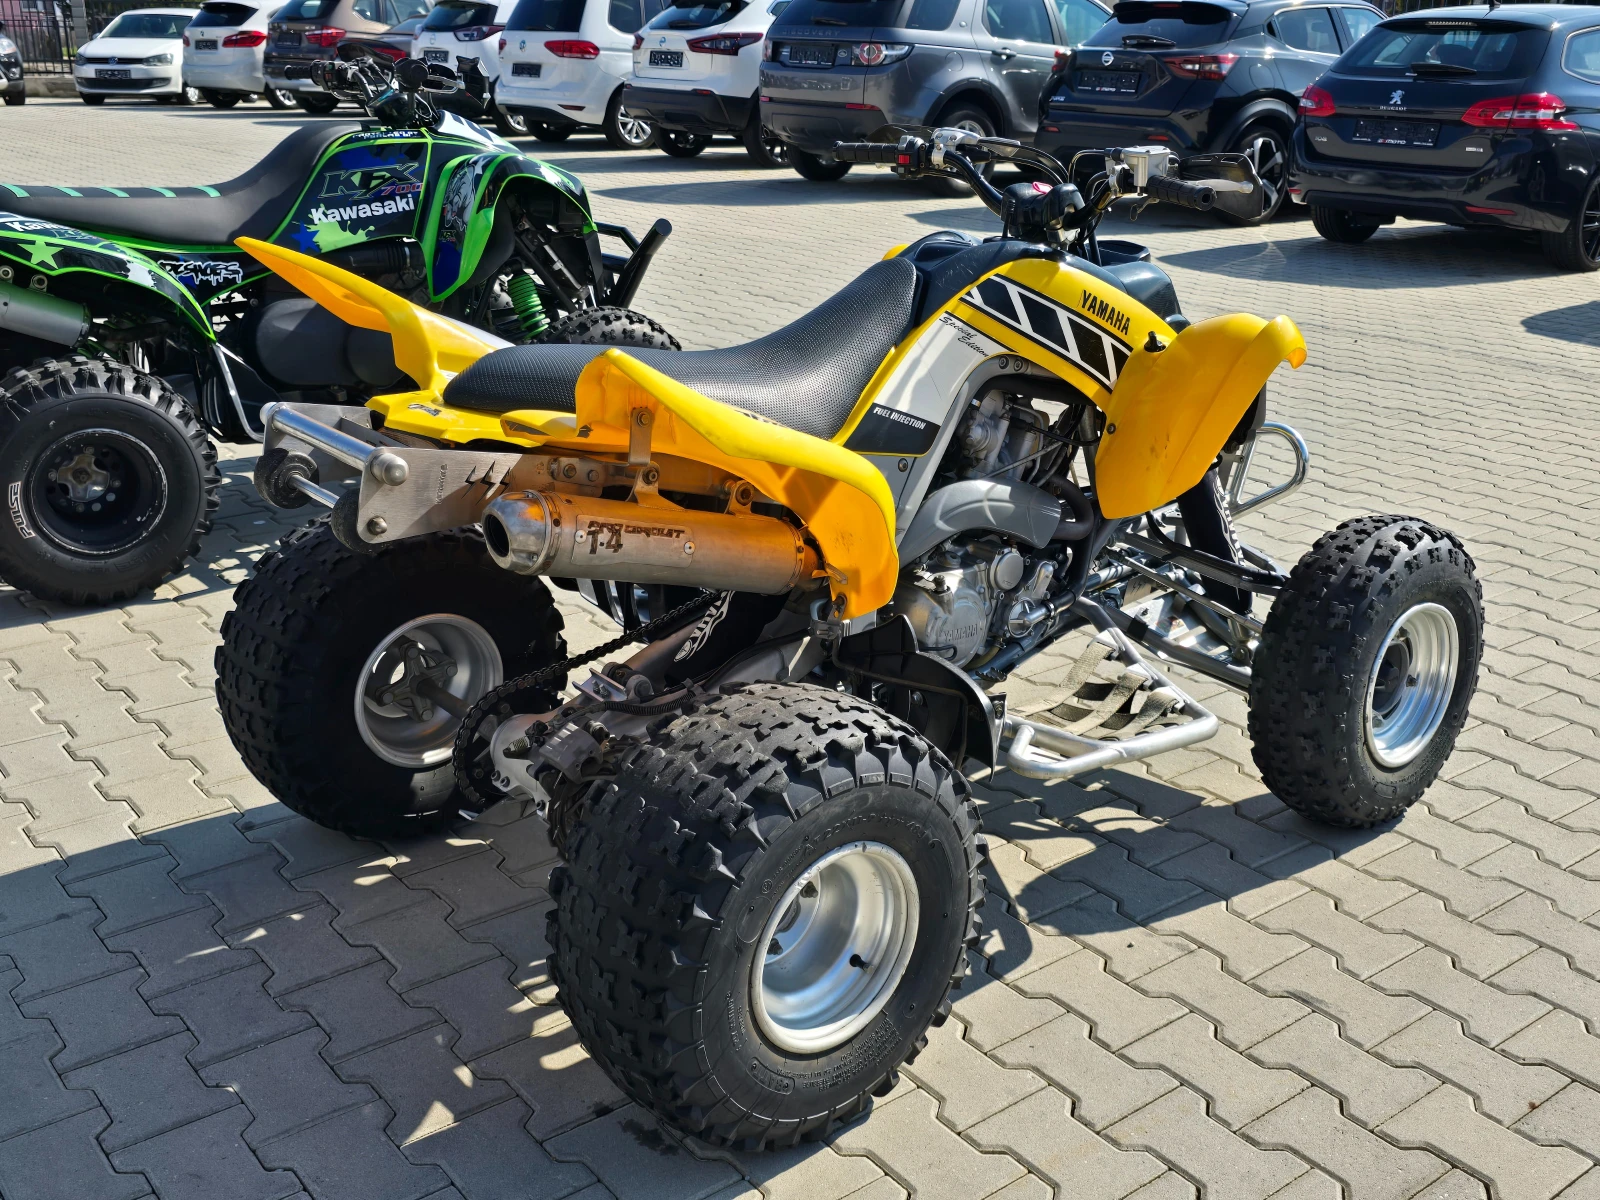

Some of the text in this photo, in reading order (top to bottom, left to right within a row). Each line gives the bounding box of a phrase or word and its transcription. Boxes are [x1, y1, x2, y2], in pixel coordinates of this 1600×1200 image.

[781, 28, 841, 37] DISCOVERY
[318, 162, 420, 200] KFX
[380, 182, 424, 196] 700
[310, 194, 415, 225] Kawasaki
[1081, 289, 1132, 336] YAMAHA
[938, 315, 975, 339] Special
[957, 334, 990, 358] Edition
[873, 406, 927, 430] FUEL INJECTION
[8, 481, 36, 539] PULSE
[587, 520, 686, 539] PRO CIRCUIT
[943, 622, 979, 642] YAMAHA
